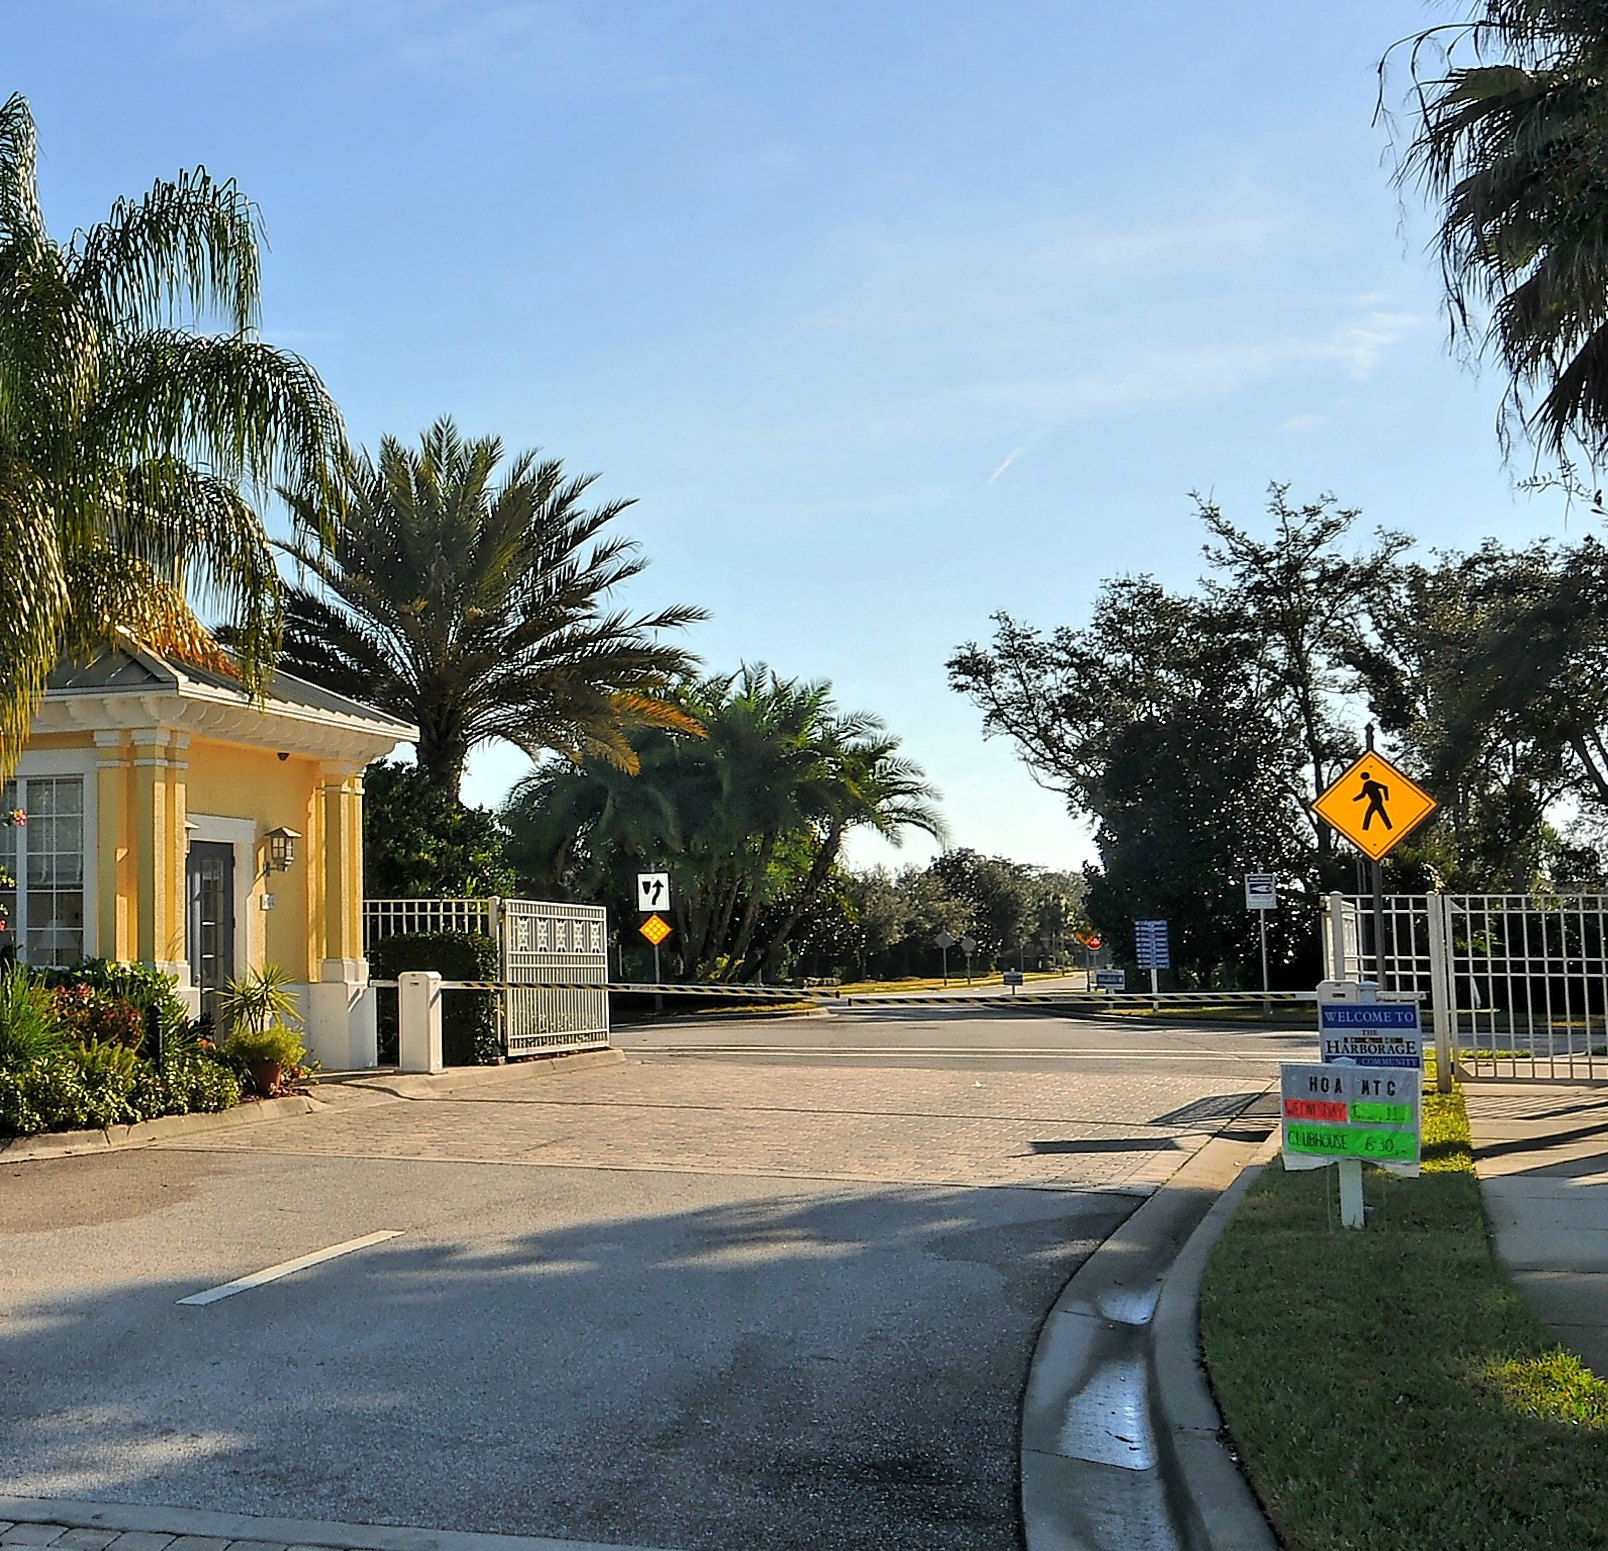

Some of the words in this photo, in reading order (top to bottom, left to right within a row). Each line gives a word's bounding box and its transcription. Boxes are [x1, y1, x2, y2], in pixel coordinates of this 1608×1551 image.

[1324, 1011, 1392, 1023] WELCOME
[1395, 1011, 1414, 1023] TO
[1326, 1040, 1417, 1055] HARBORAGE
[1361, 1058, 1417, 1067] COMMUNITY
[1309, 1076, 1342, 1094] HOA
[1287, 1131, 1348, 1150] CLUBHOUSE
